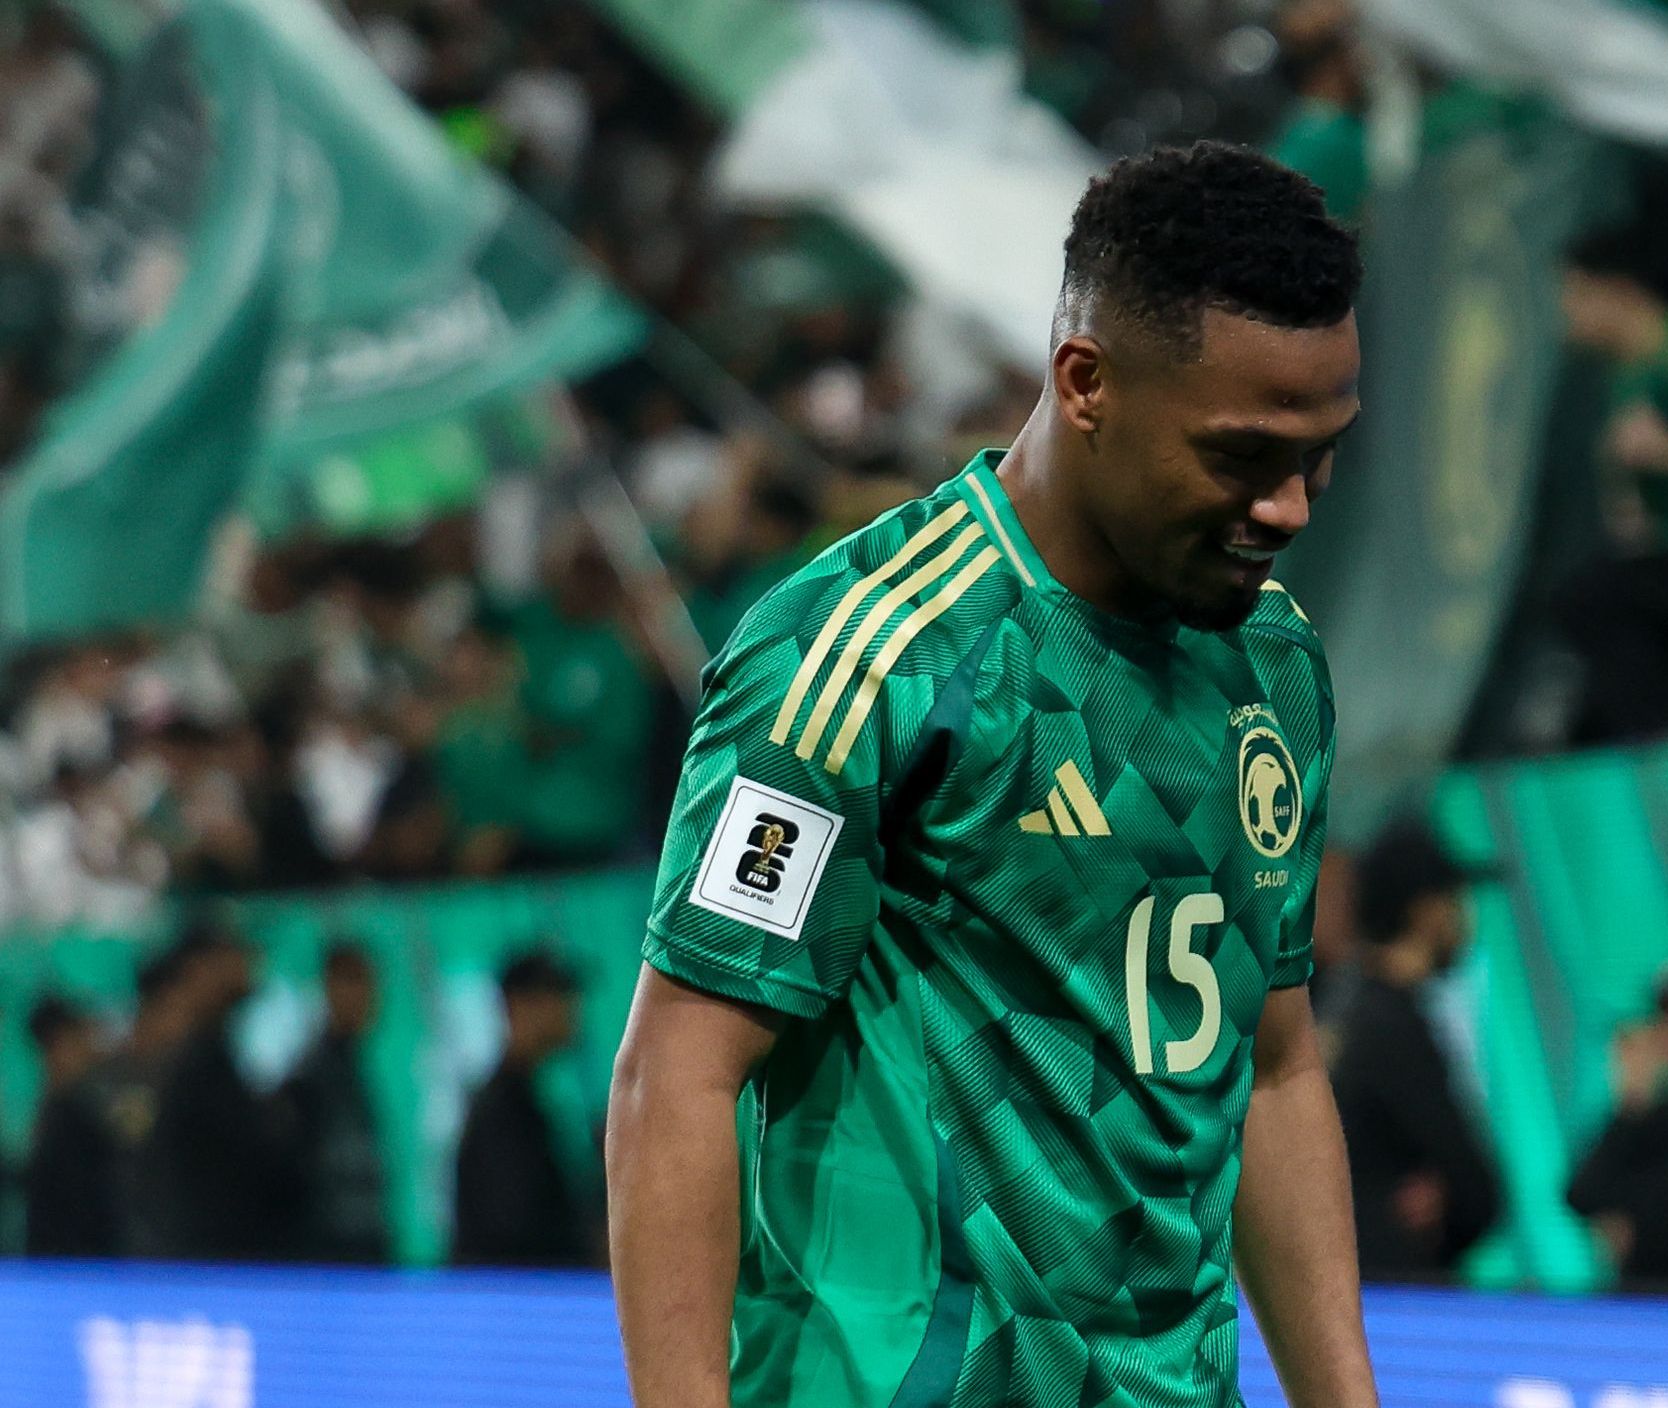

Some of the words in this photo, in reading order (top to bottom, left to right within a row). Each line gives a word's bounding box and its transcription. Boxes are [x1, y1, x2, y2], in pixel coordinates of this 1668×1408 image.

[746, 870, 769, 887] FIFA
[1254, 869, 1288, 889] SAUDI
[1126, 893, 1224, 1074] 15
